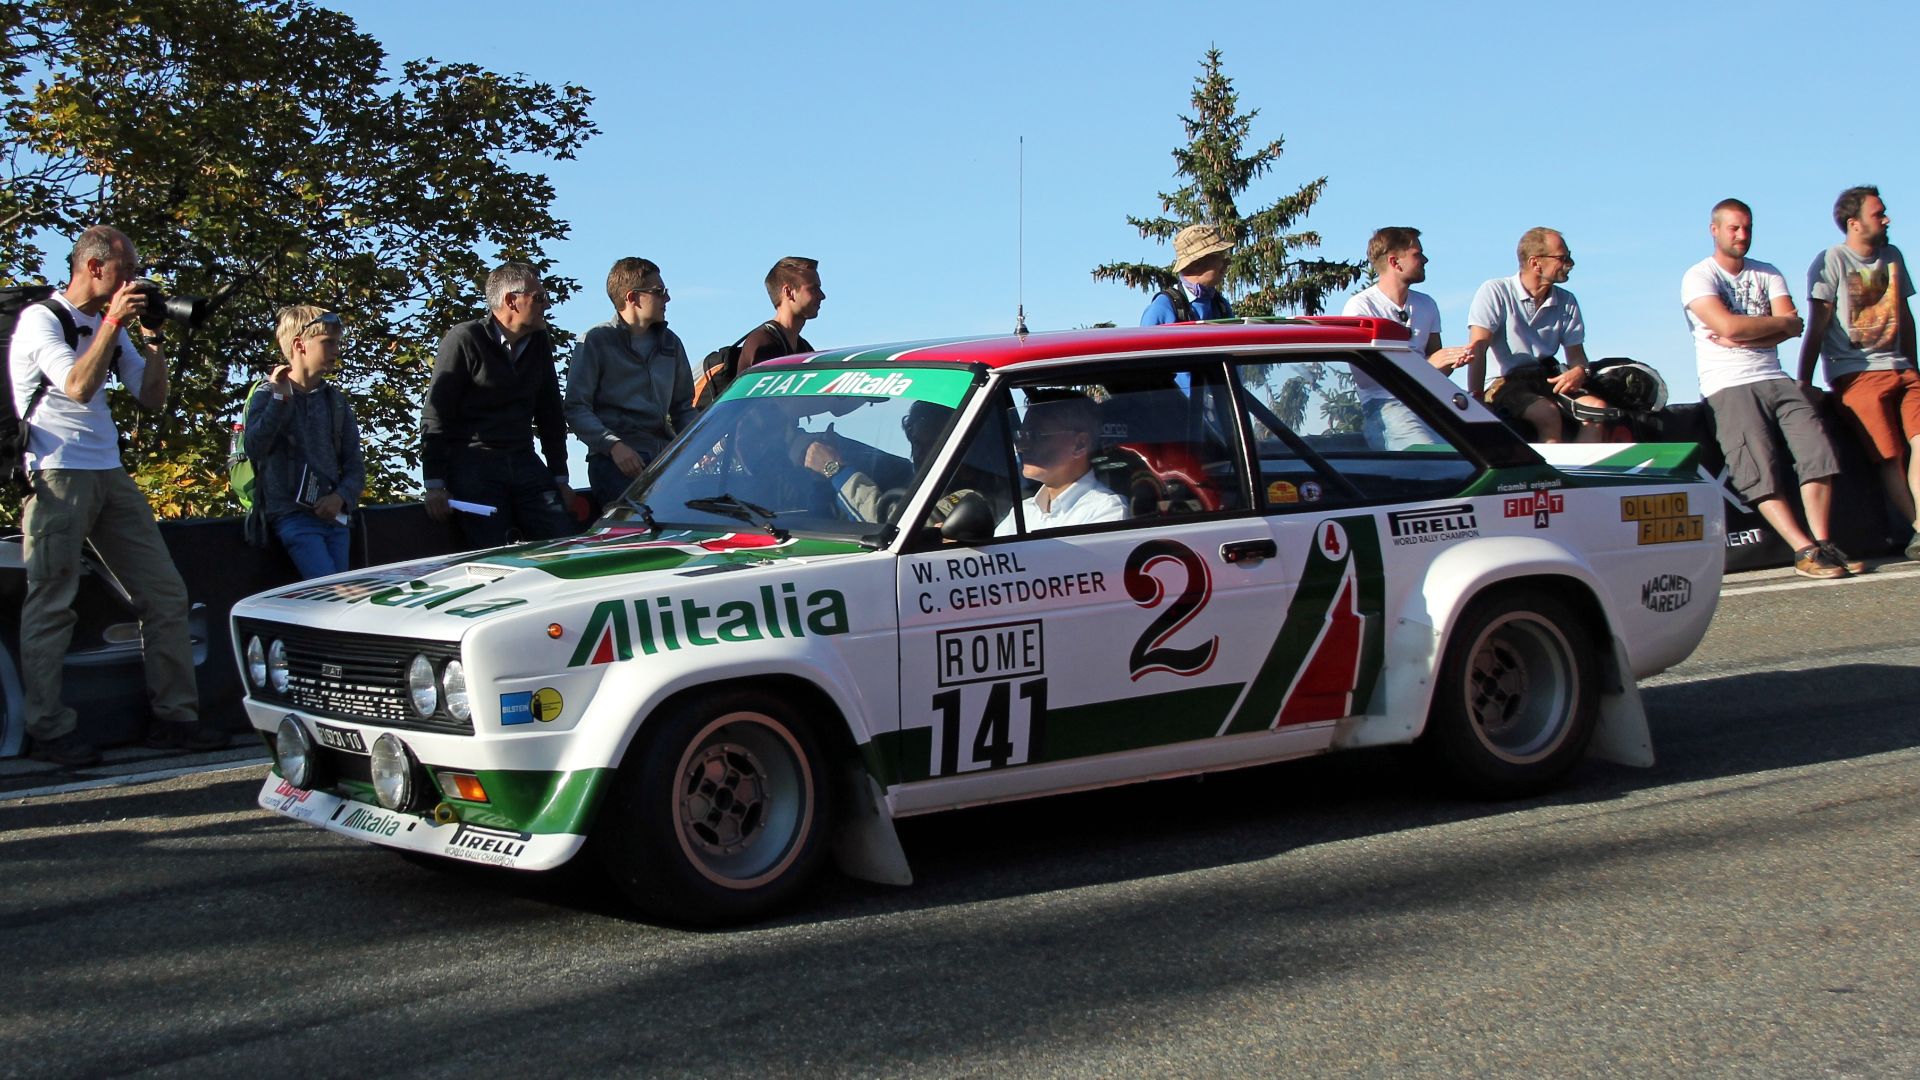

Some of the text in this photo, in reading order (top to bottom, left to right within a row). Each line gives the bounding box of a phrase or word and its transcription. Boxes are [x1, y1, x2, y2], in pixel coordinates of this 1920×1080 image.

[746, 371, 913, 397] FIAT Alitalia
[1497, 478, 1561, 492] ricambi originali
[1505, 492, 1563, 517] FIAT
[1625, 497, 1685, 517] OLIO
[1387, 504, 1477, 537] PIRELLI
[1643, 520, 1700, 540] FIAT
[1325, 524, 1340, 555] 4
[1393, 530, 1479, 546] WORLD RALLY CHAMPION
[1726, 528, 1761, 547] ERT
[912, 552, 1026, 584] W. ROHRL
[919, 571, 1107, 615] C. GEISTDORFER
[1124, 539, 1219, 682] 2
[567, 582, 849, 668] Alitalia
[945, 629, 1037, 677] ROME
[502, 704, 529, 714] BILSTEIN
[931, 678, 1048, 776] 141
[341, 808, 401, 836] Alitalia
[448, 821, 532, 857] PIRELLI
[445, 847, 464, 857] WORLD
[481, 852, 516, 867] CHAMPION
